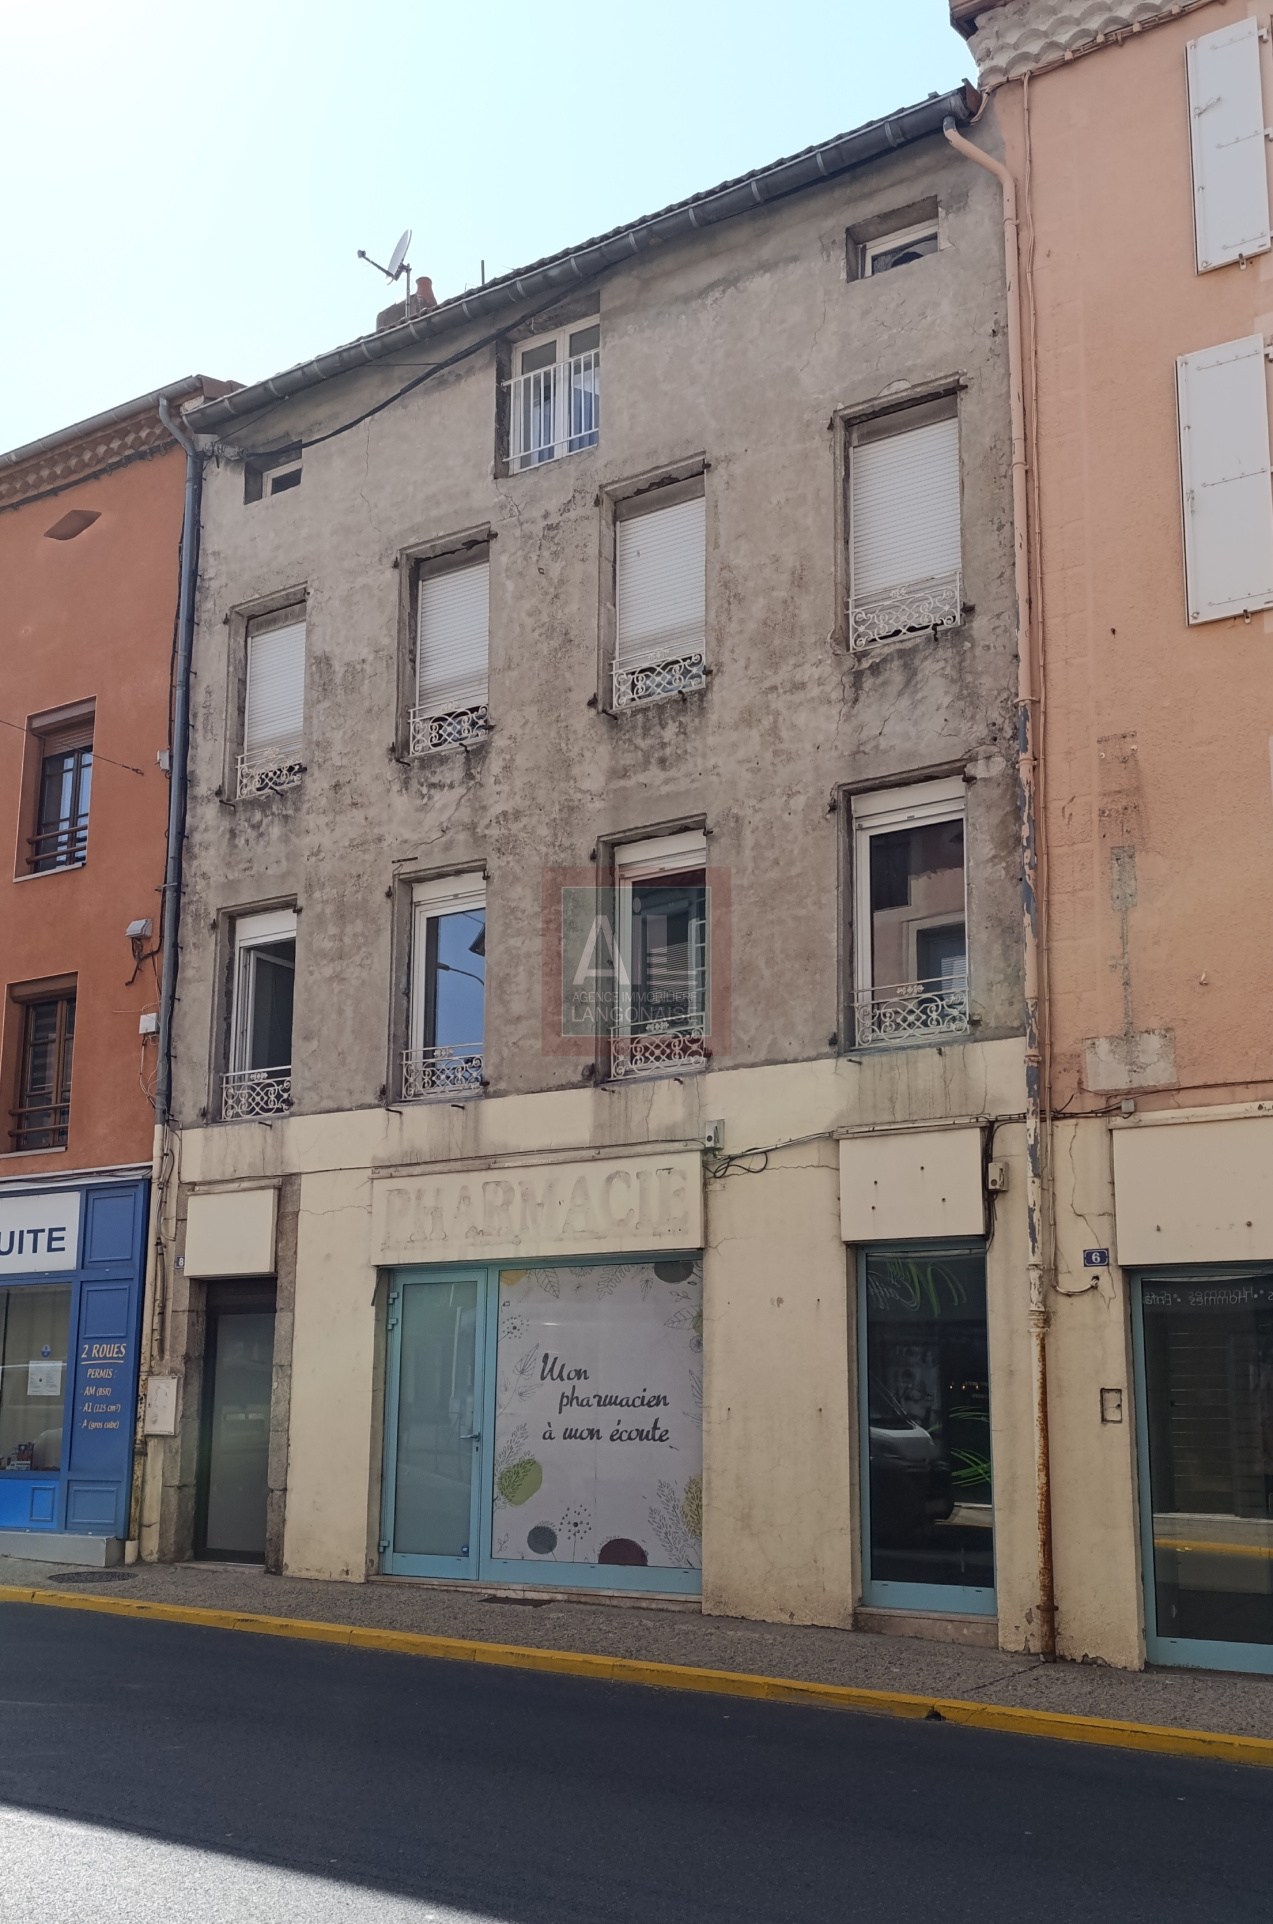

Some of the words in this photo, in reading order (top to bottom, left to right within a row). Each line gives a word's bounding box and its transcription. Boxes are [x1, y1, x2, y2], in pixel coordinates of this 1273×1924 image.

[382, 1167, 689, 1251] PHARMACIE
[0, 1227, 66, 1256] UITE
[178, 1257, 184, 1266] 8
[1091, 1252, 1101, 1263] 6
[81, 1344, 89, 1358] 2
[91, 1343, 127, 1358] ROUES
[86, 1368, 113, 1379] PERMIS
[83, 1386, 96, 1396] AM
[96, 1387, 112, 1397] (BSR)
[558, 1385, 670, 1414] pharmacien
[81, 1419, 88, 1429] A
[542, 1422, 555, 1440] à
[562, 1426, 602, 1441] mon
[609, 1417, 670, 1442] écoute
